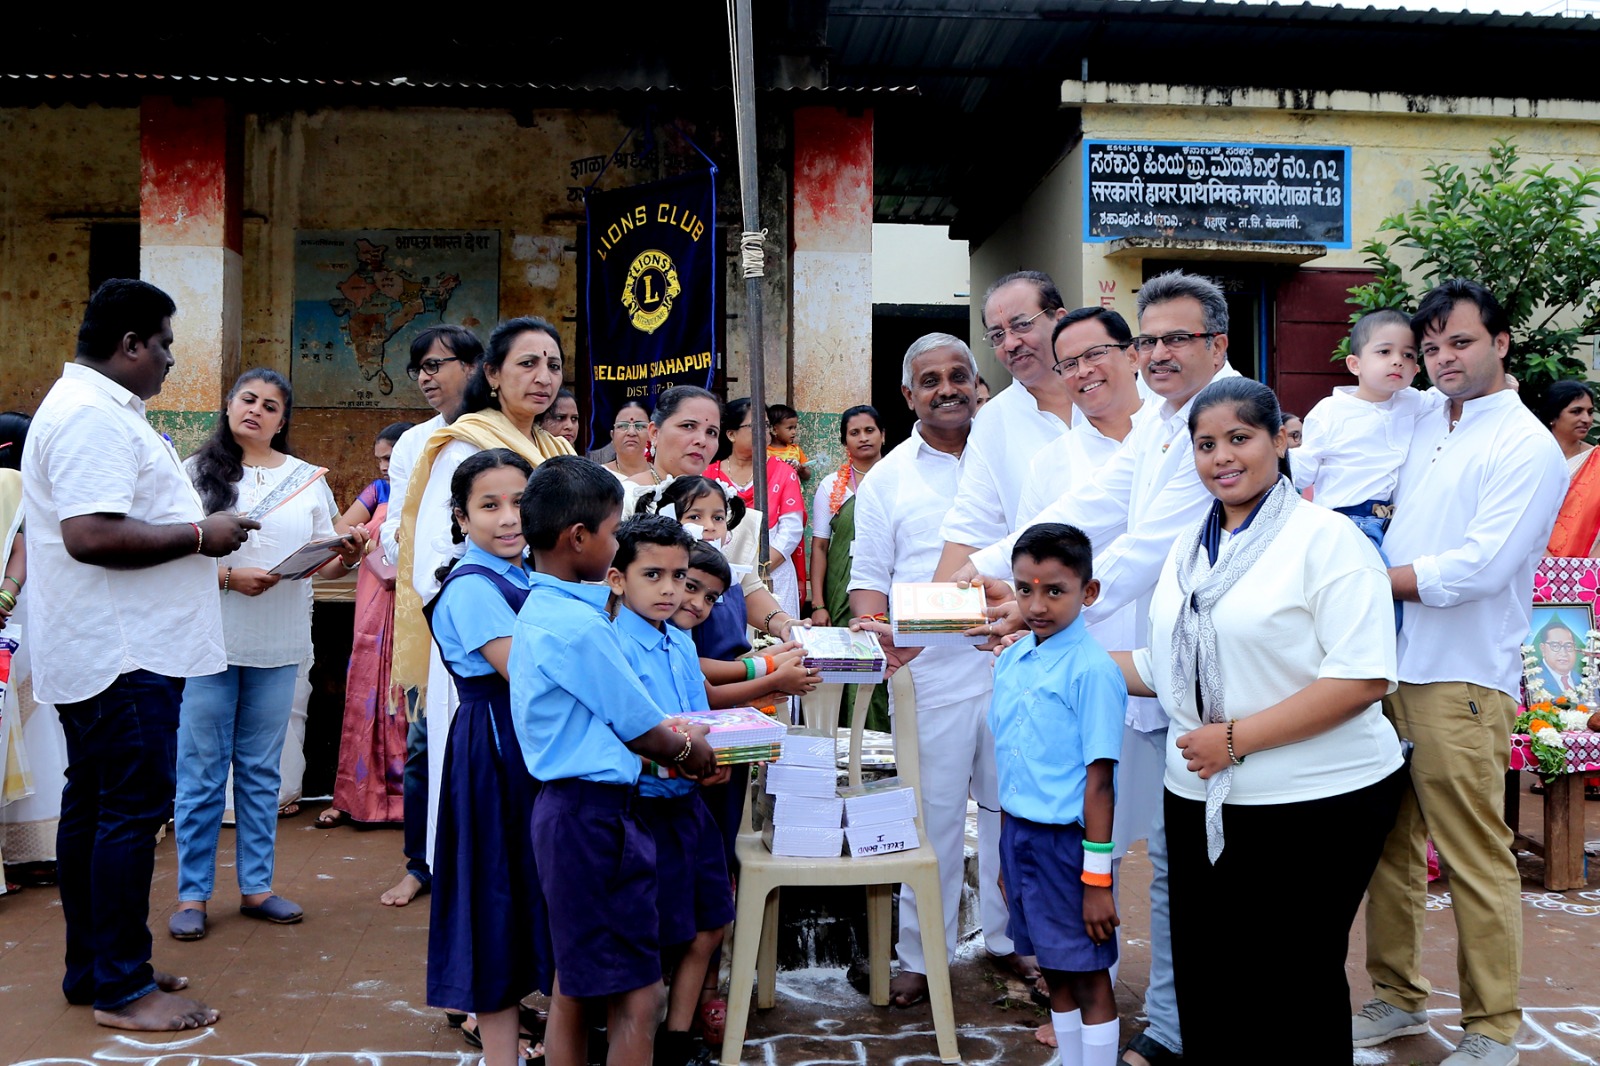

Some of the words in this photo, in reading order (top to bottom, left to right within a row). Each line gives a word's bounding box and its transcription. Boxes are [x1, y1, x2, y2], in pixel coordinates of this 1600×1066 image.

[1091, 151, 1140, 175] ಸರಕಾರಿ
[1144, 152, 1185, 175] ಹಿರಿಯ
[1091, 175, 1144, 203] सरकारी
[1146, 182, 1179, 207] हायर
[1179, 178, 1242, 205] प्राथमिक
[1242, 179, 1280, 205] मराठी
[1280, 185, 1311, 206] शाळा
[597, 205, 648, 262] LIONS
[657, 203, 705, 243] CLUB
[633, 255, 668, 273] LIONS
[643, 275, 660, 304] L
[593, 363, 648, 381] BELGAUM
[626, 385, 649, 398] DIST.
